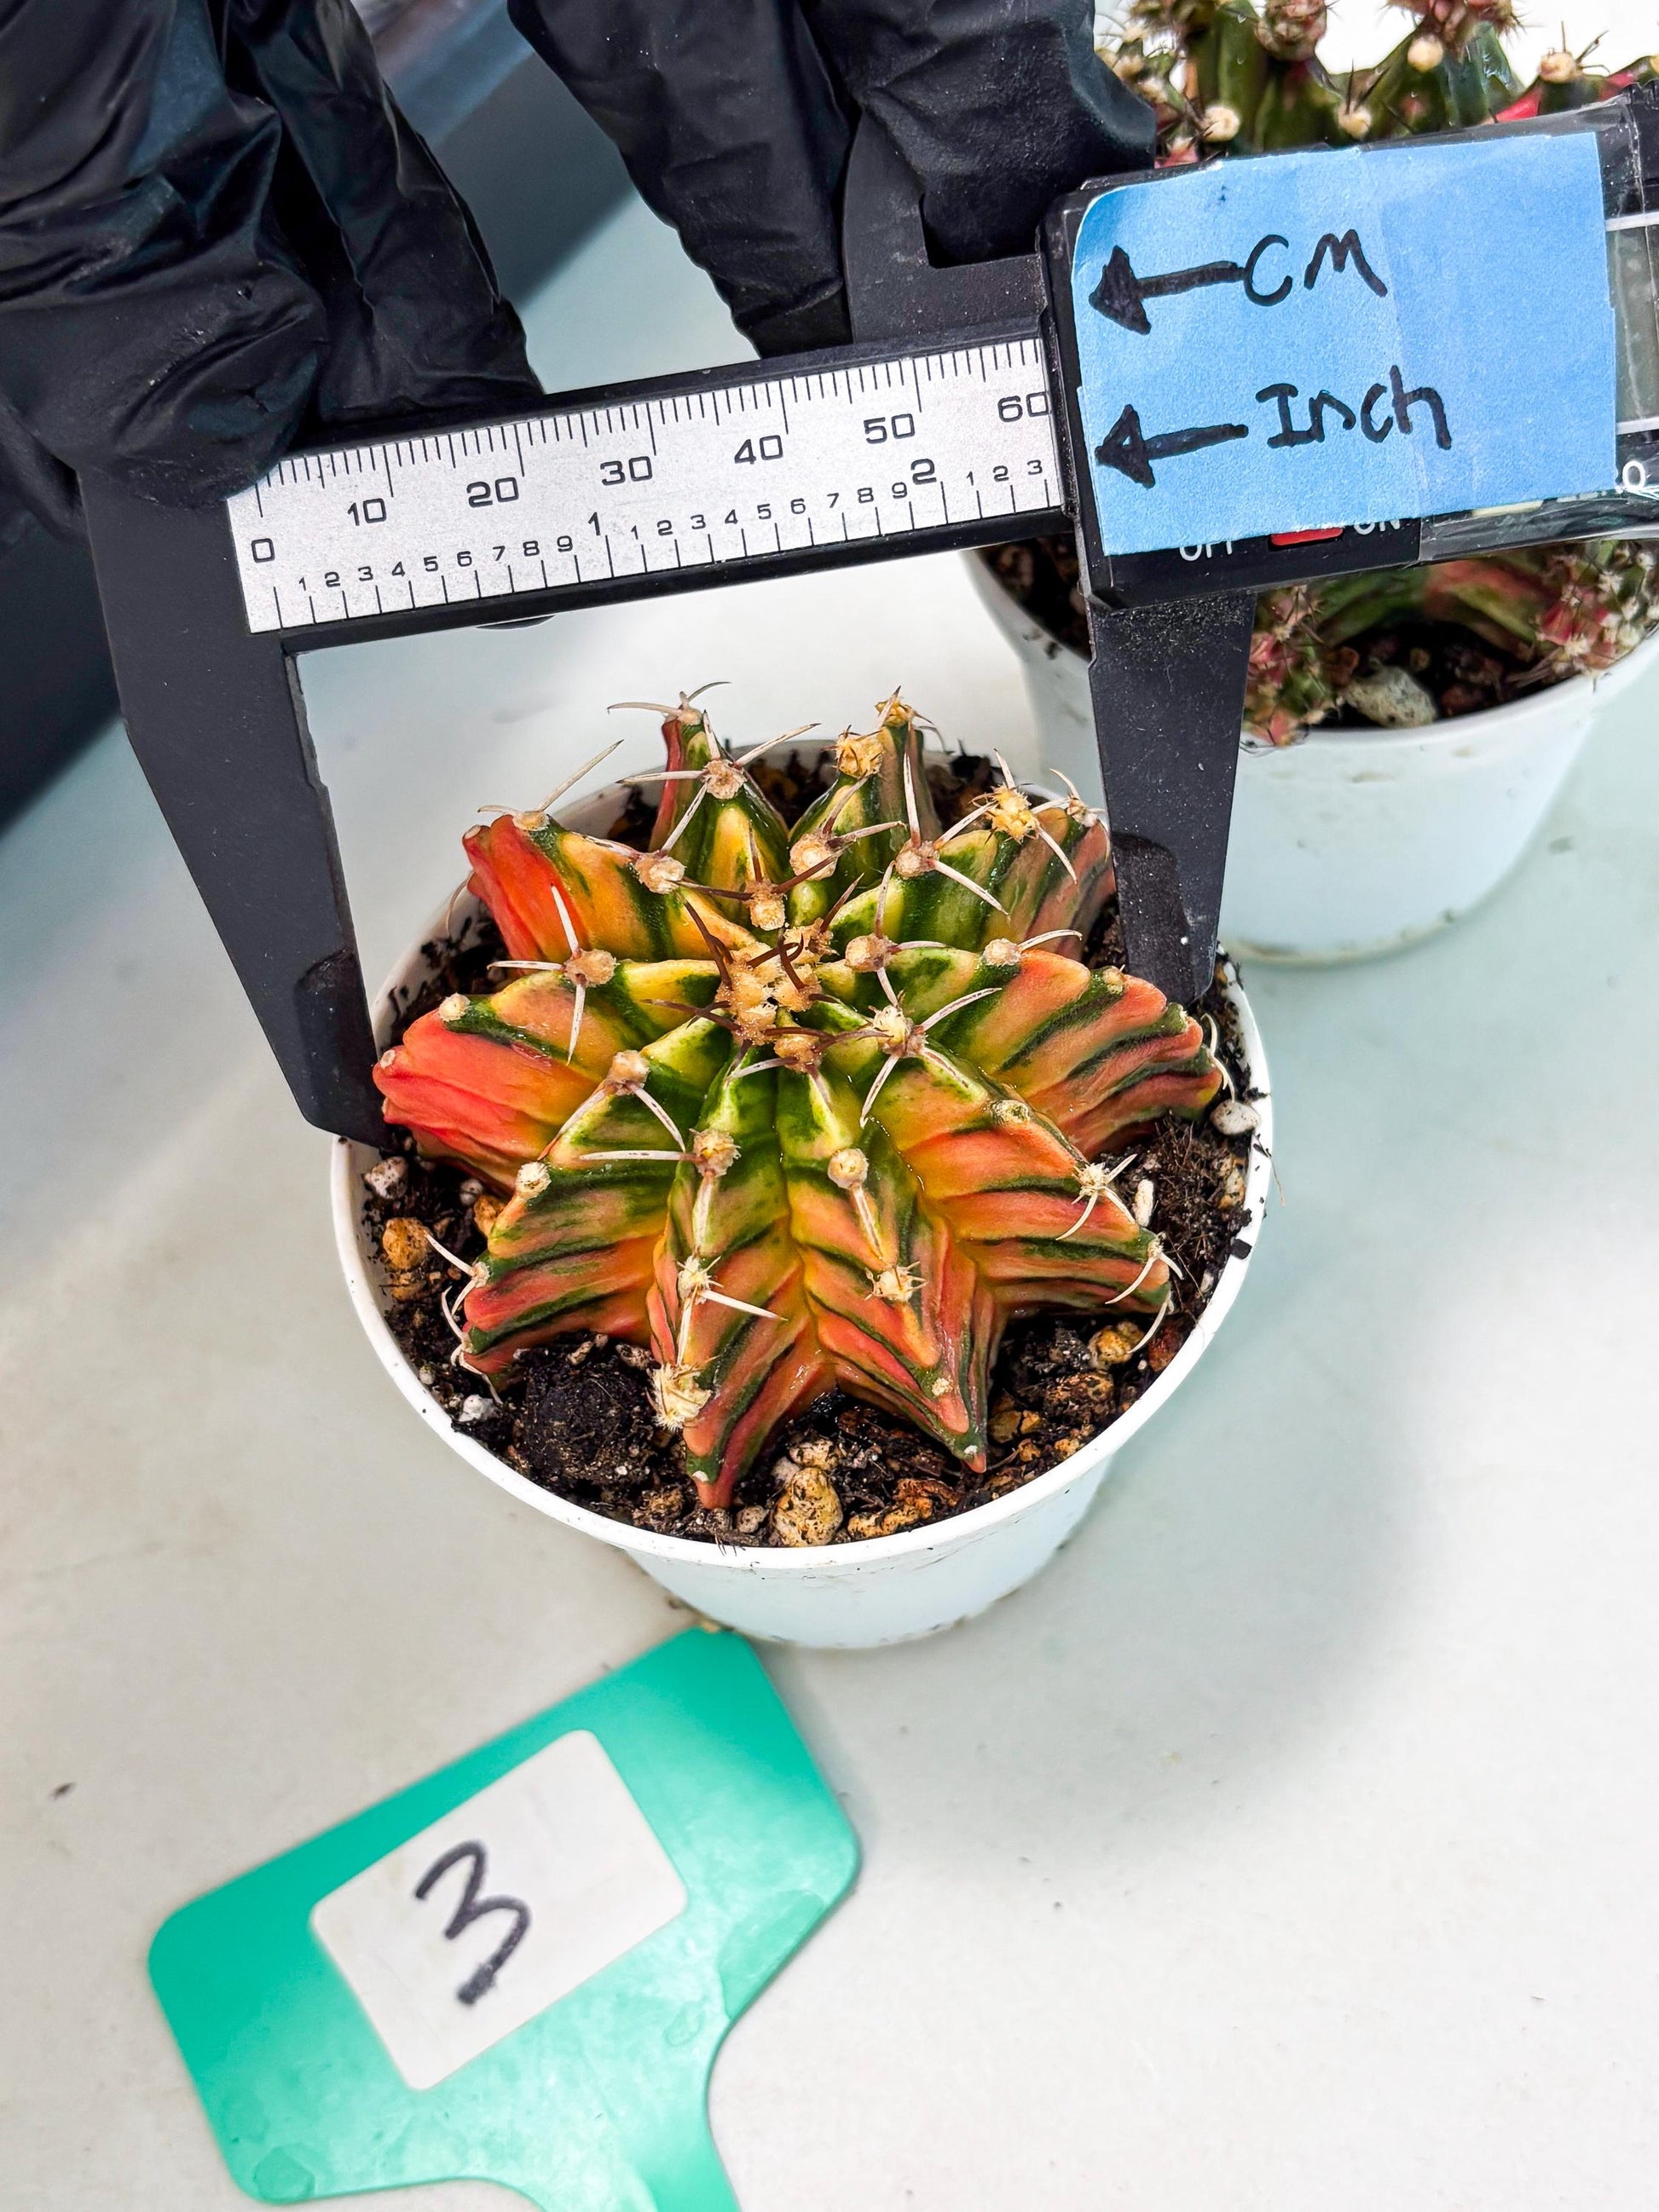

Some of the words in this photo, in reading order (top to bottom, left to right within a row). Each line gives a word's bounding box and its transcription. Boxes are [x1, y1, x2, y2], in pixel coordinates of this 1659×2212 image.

[251, 537, 275, 563] 0
[347, 498, 387, 527] 10
[465, 477, 519, 508] 20
[599, 455, 653, 486] 30
[734, 435, 783, 465] 40
[863, 413, 916, 444] 50
[997, 390, 1051, 423] 60
[1255, 365, 1452, 451] Inch
[298, 577, 307, 592] 1
[324, 571, 341, 588] 2
[357, 565, 373, 582] 3
[391, 561, 406, 577] 4
[423, 555, 439, 572] 5
[456, 551, 472, 568] 6
[492, 545, 506, 562] 7
[522, 540, 540, 557] 8
[556, 535, 574, 553] 9
[587, 511, 601, 536] 1
[630, 525, 639, 540] 1
[656, 519, 673, 536] 2
[690, 514, 706, 530] 3
[724, 509, 738, 524] 4
[756, 503, 772, 520] 5
[789, 498, 806, 515] 6
[826, 492, 840, 508] 7
[857, 487, 875, 504] 8
[891, 482, 908, 499] 9
[910, 458, 937, 485] 2
[965, 471, 974, 486] 1
[992, 465, 1009, 482] 2
[1026, 459, 1043, 476] 3
[413, 1838, 532, 2008] 3
